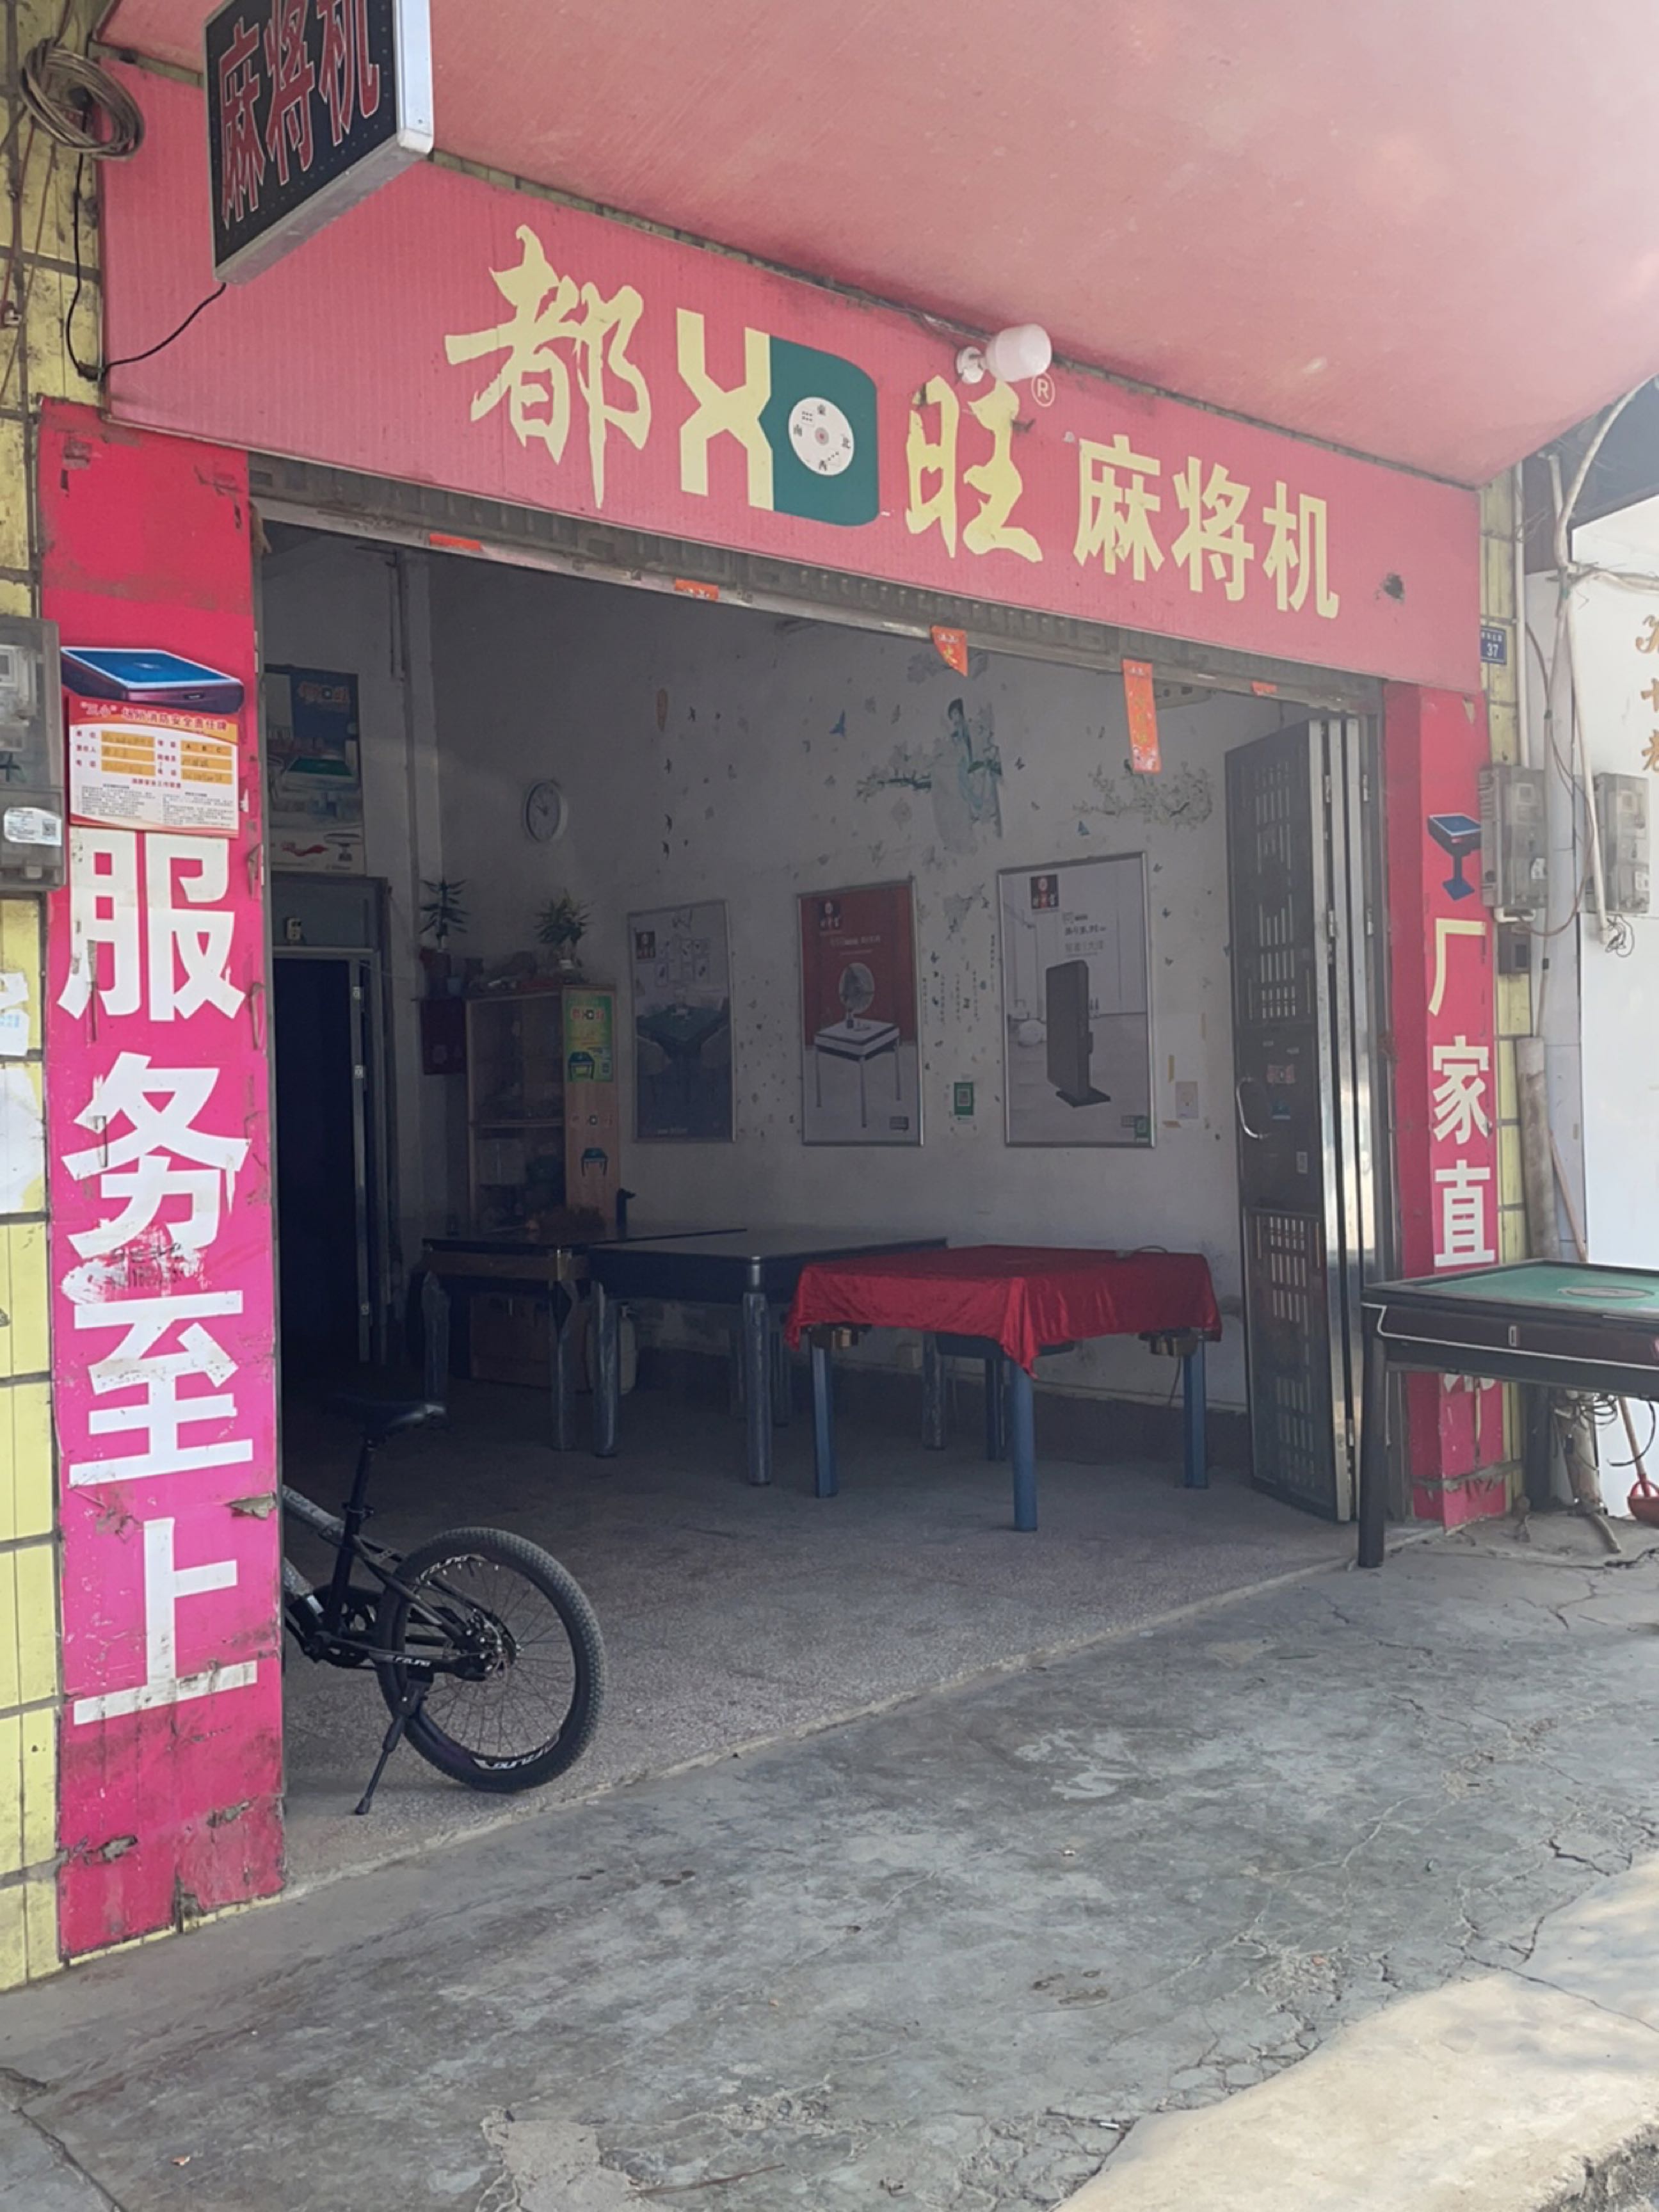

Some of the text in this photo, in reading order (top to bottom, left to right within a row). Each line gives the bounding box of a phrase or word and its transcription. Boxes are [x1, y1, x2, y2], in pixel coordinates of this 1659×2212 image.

[220, 0, 380, 229] 麻将机
[58, 828, 257, 1726] 服务至上
[1429, 918, 1496, 1393] 厂家直
